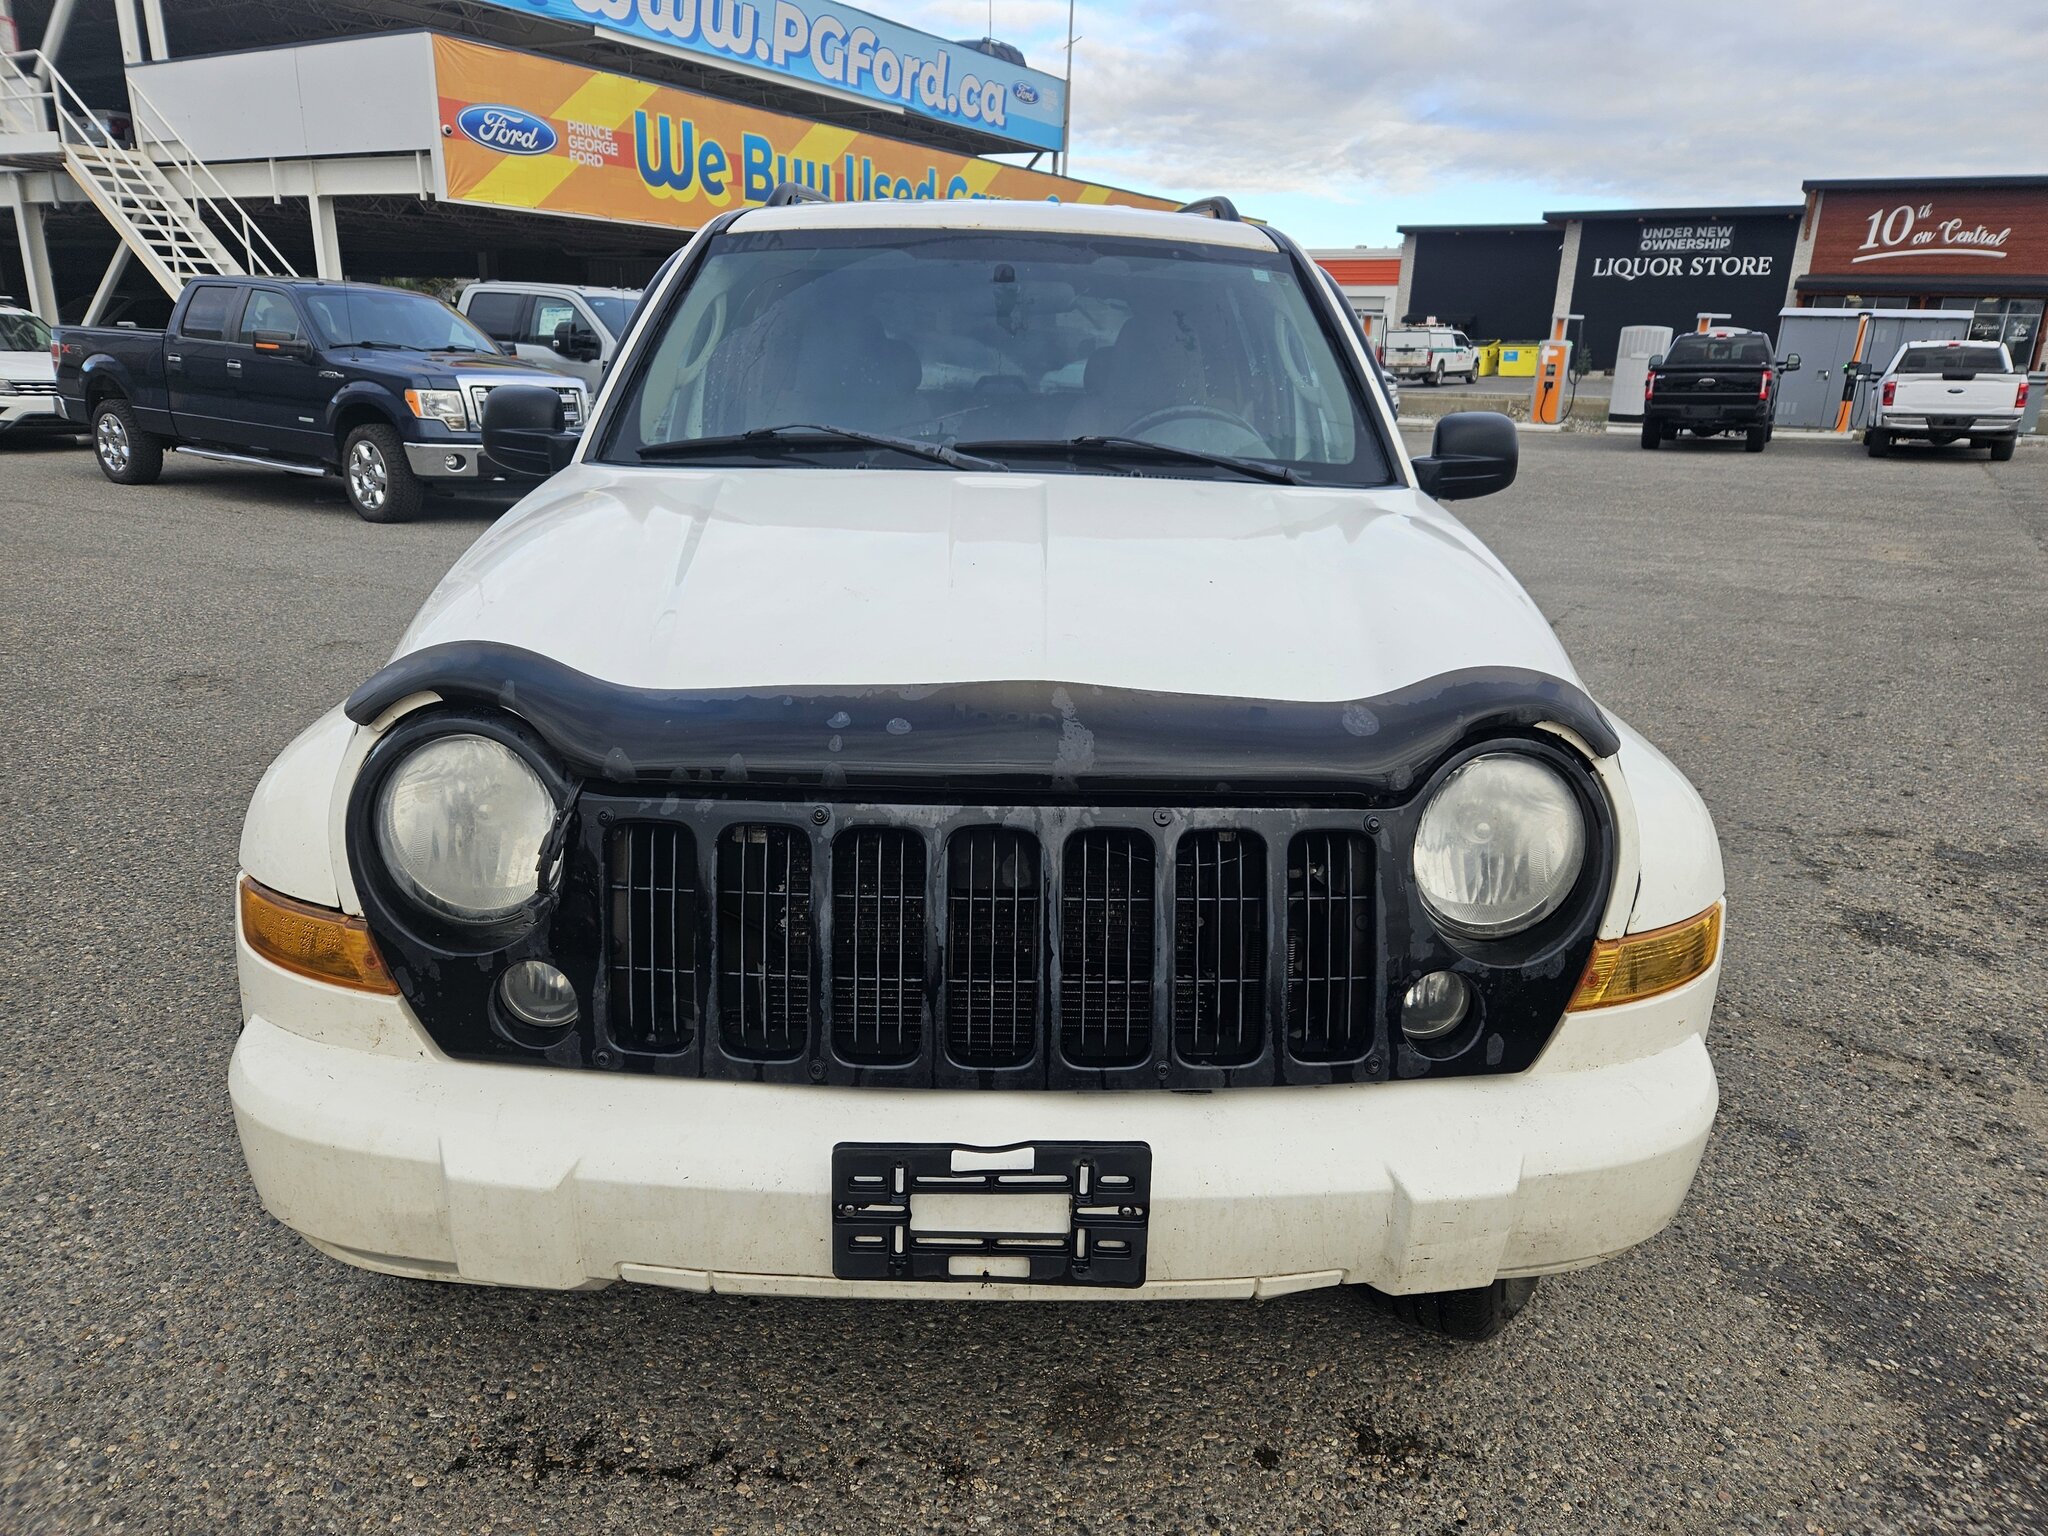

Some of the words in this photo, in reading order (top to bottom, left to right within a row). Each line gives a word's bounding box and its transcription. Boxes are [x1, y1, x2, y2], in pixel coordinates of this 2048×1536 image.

[479, 111, 539, 149] Ford
[567, 120, 613, 141] PRINCE
[568, 135, 619, 156] GEORGE
[634, 110, 727, 196] We
[569, 149, 604, 168] FORD
[1642, 226, 1693, 239] UNDER
[1696, 226, 1734, 238] NEW
[1911, 231, 1937, 246] on
[1938, 218, 2012, 247] Central
[1640, 238, 1731, 251] OWNERSHIP
[1592, 257, 1683, 281] LIQUOR
[1689, 256, 1772, 276] STORE
